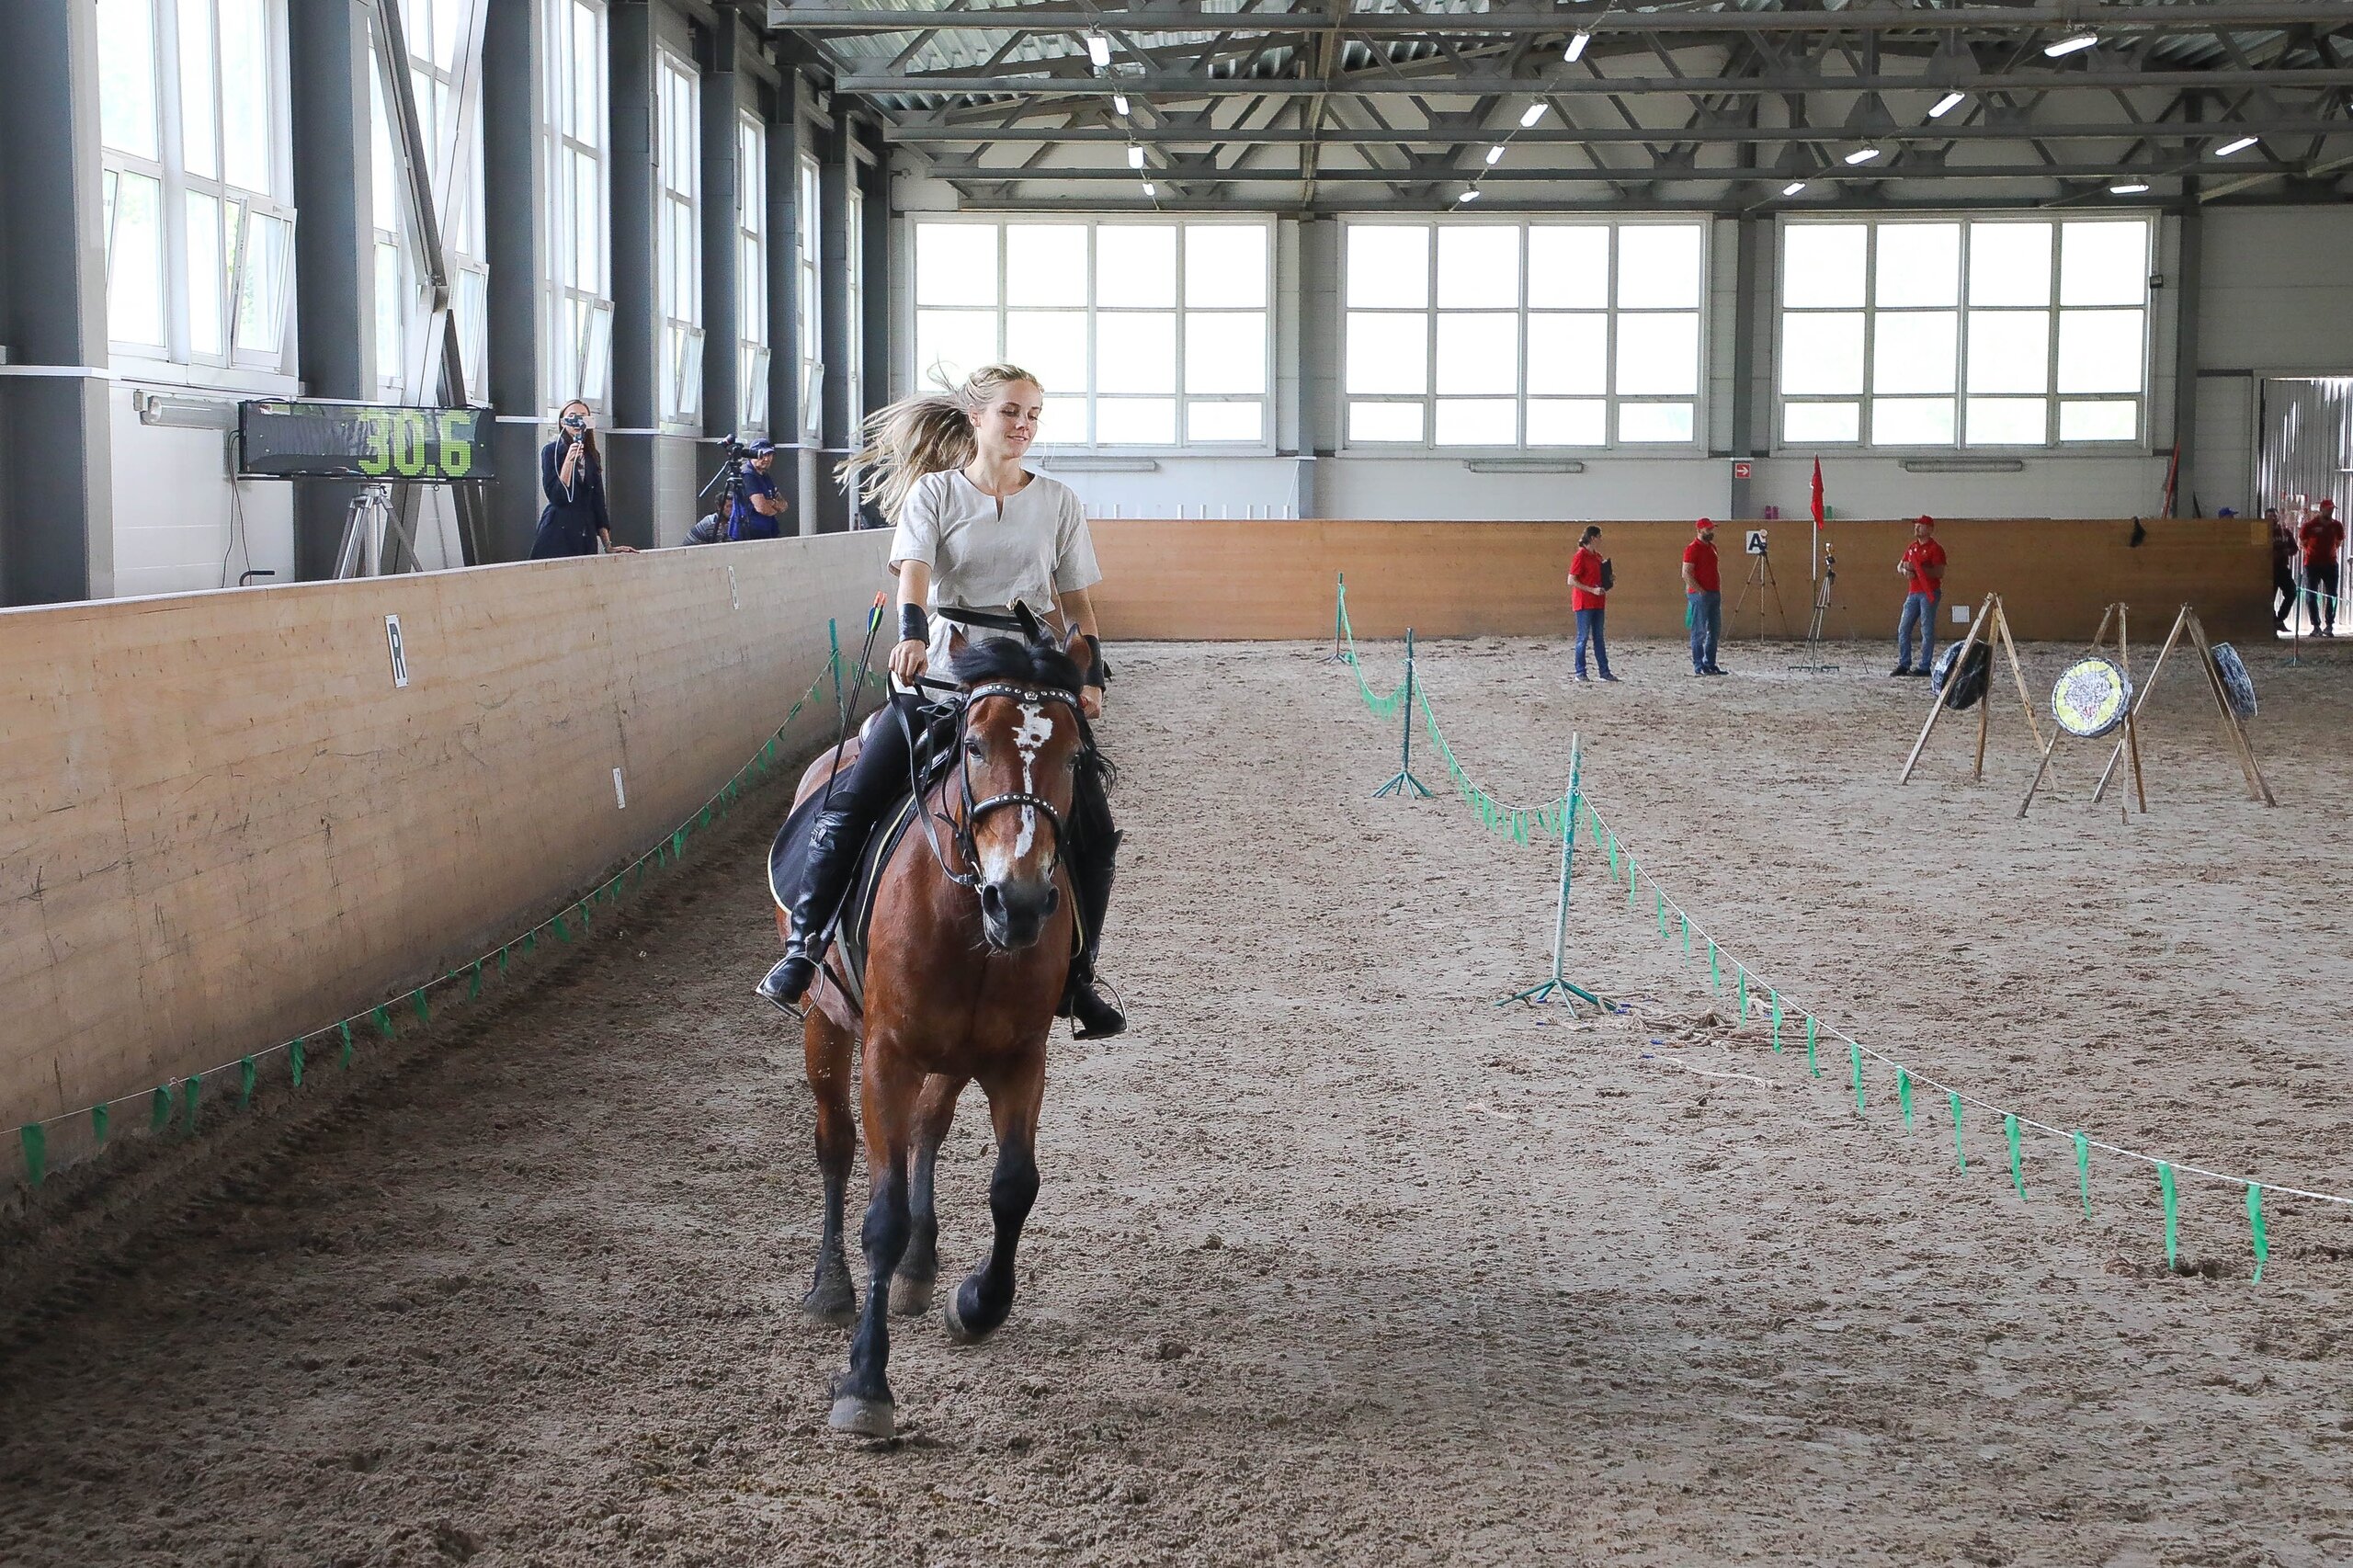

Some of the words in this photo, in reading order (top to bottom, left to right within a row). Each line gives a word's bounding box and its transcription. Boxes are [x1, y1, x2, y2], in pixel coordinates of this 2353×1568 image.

[358, 410, 471, 477] 30.6
[1748, 533, 1765, 551] A
[389, 623, 405, 679] R
